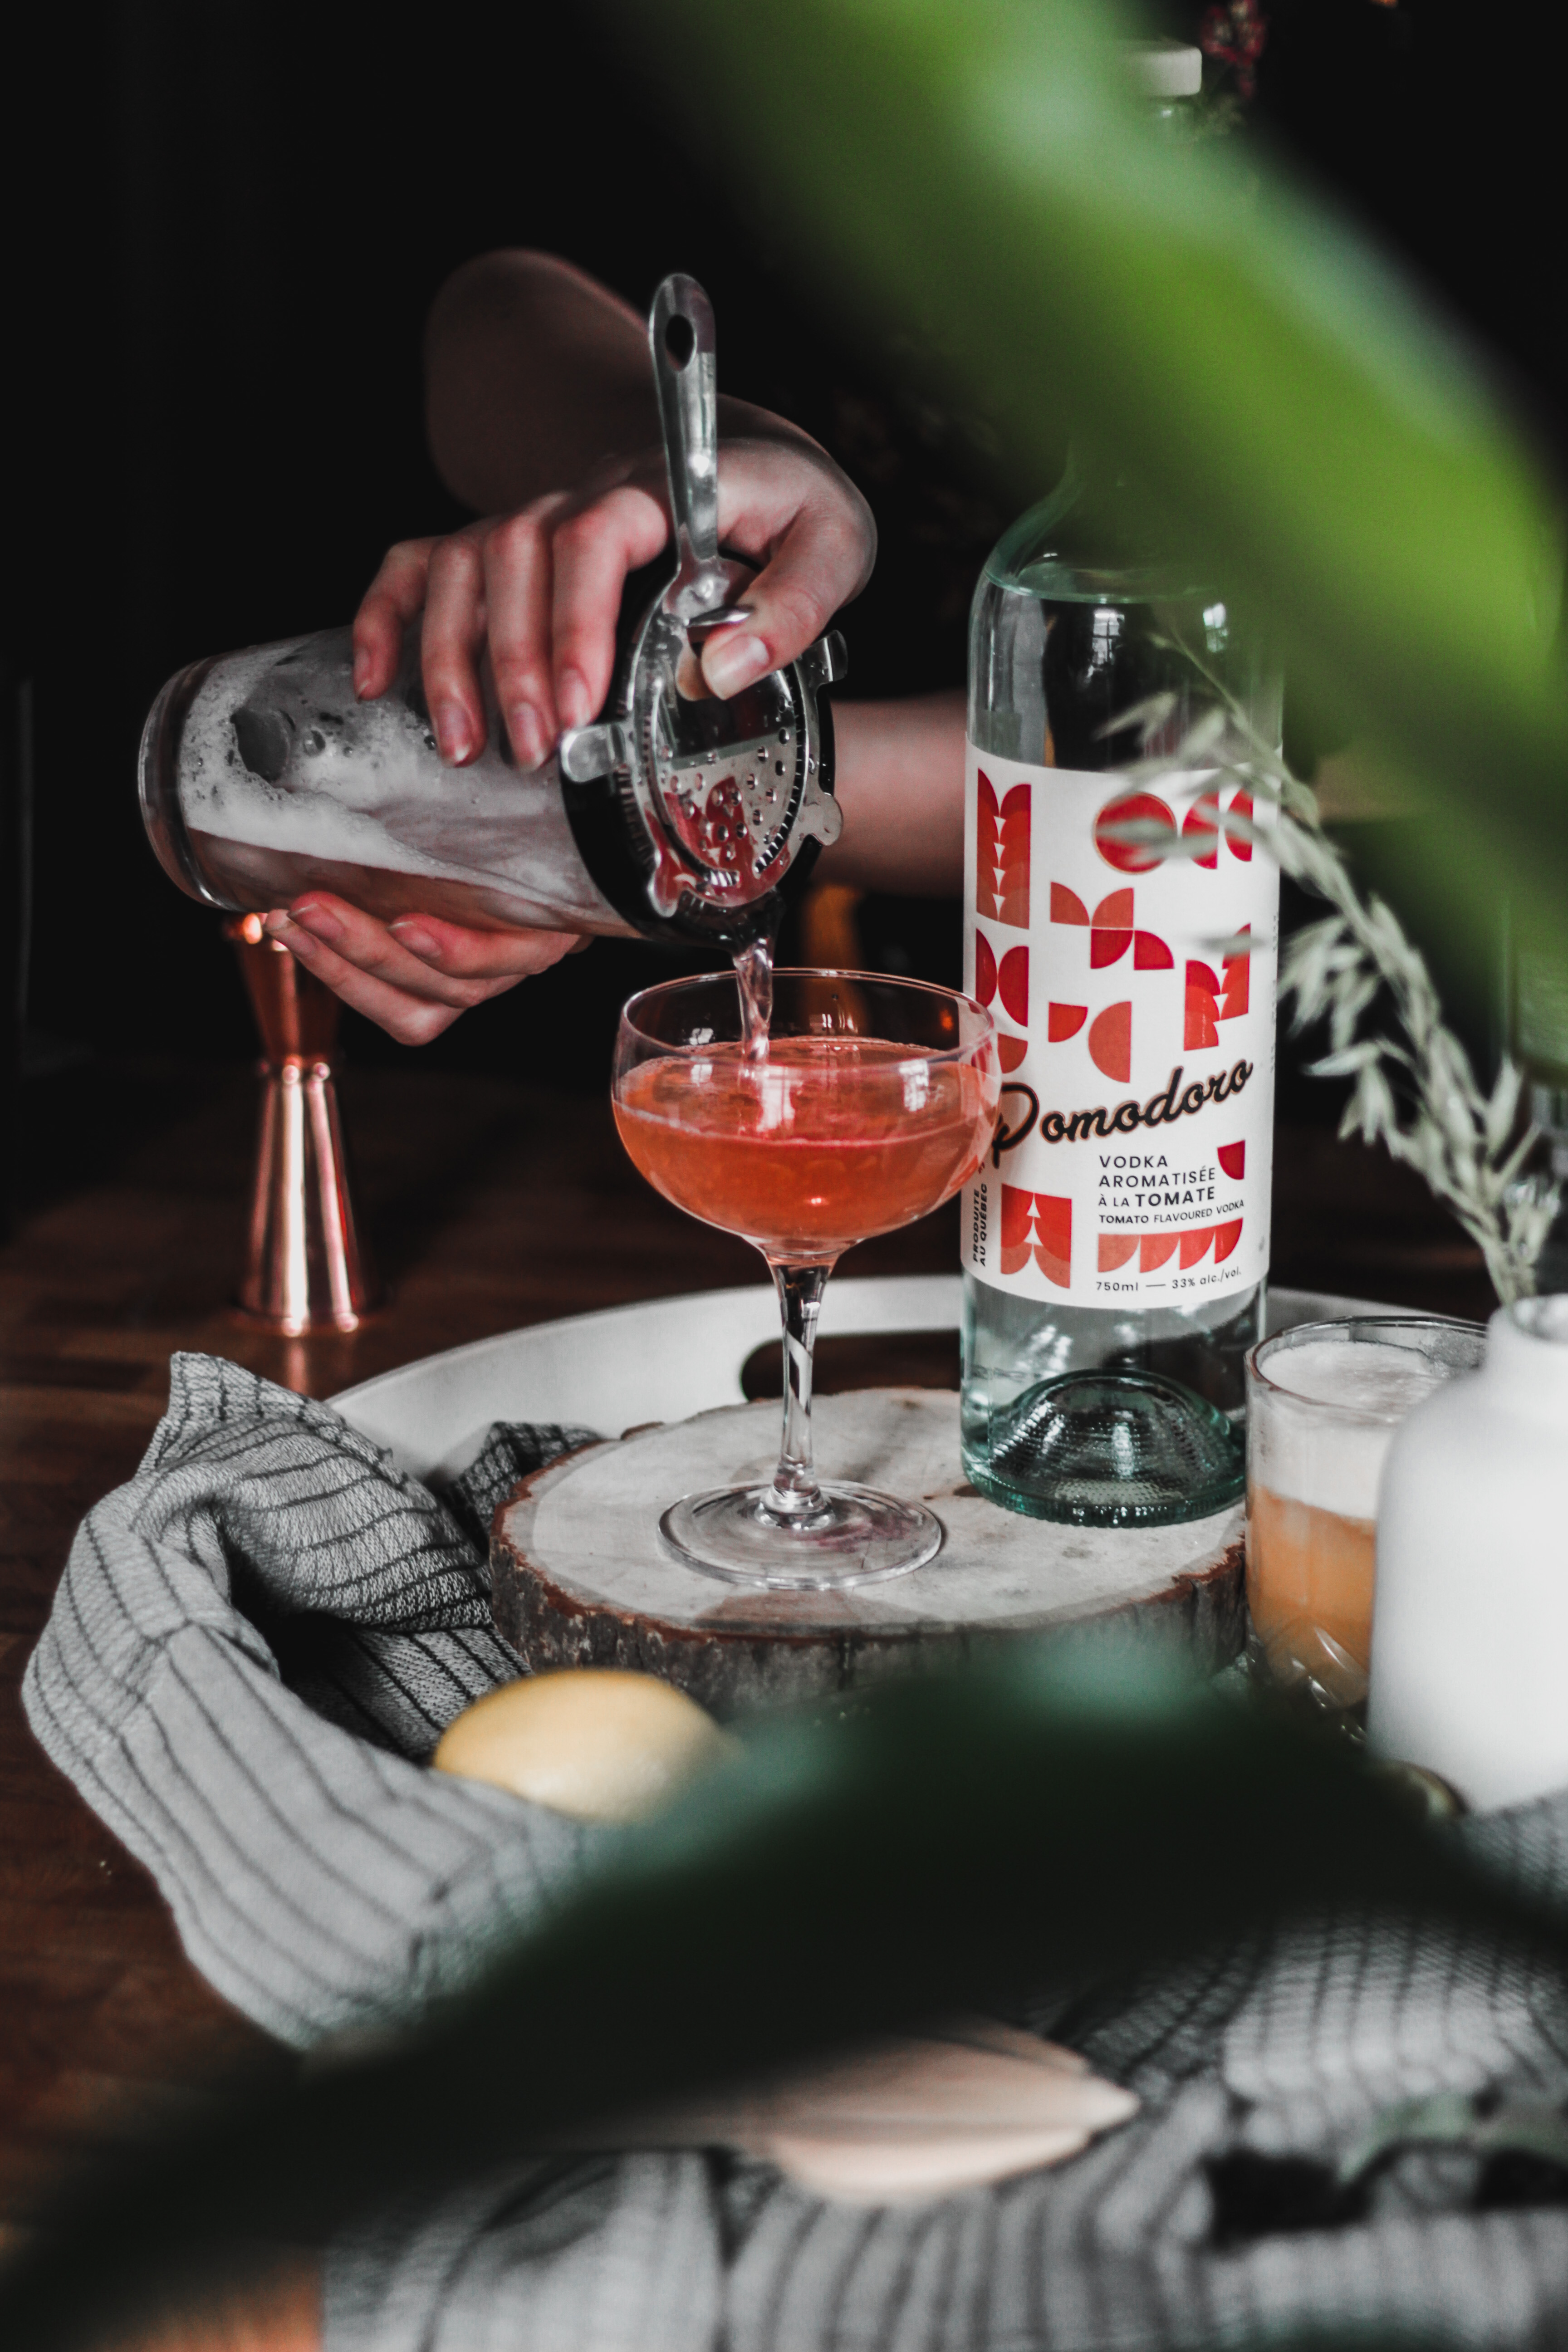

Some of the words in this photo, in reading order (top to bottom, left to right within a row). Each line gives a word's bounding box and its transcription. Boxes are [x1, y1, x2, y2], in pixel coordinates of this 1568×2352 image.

[991, 1058, 1254, 1169] Pomodoro
[1099, 1155, 1168, 1168] VODKA
[1099, 1165, 1215, 1187] AROMATISÉE
[1098, 1193, 1107, 1206] À
[1113, 1197, 1130, 1207] LA
[1135, 1186, 1215, 1207] TOMATE
[979, 1182, 987, 1241] QUÉBEC
[1099, 1215, 1149, 1224] TOMATO
[1154, 1208, 1212, 1223] FLAVOURED
[1216, 1199, 1244, 1214] VODKA
[980, 1245, 985, 1267] AU
[1096, 1282, 1138, 1291] 750ml
[1172, 1278, 1196, 1289] 33%
[1200, 1267, 1241, 1285] alc./vol.
